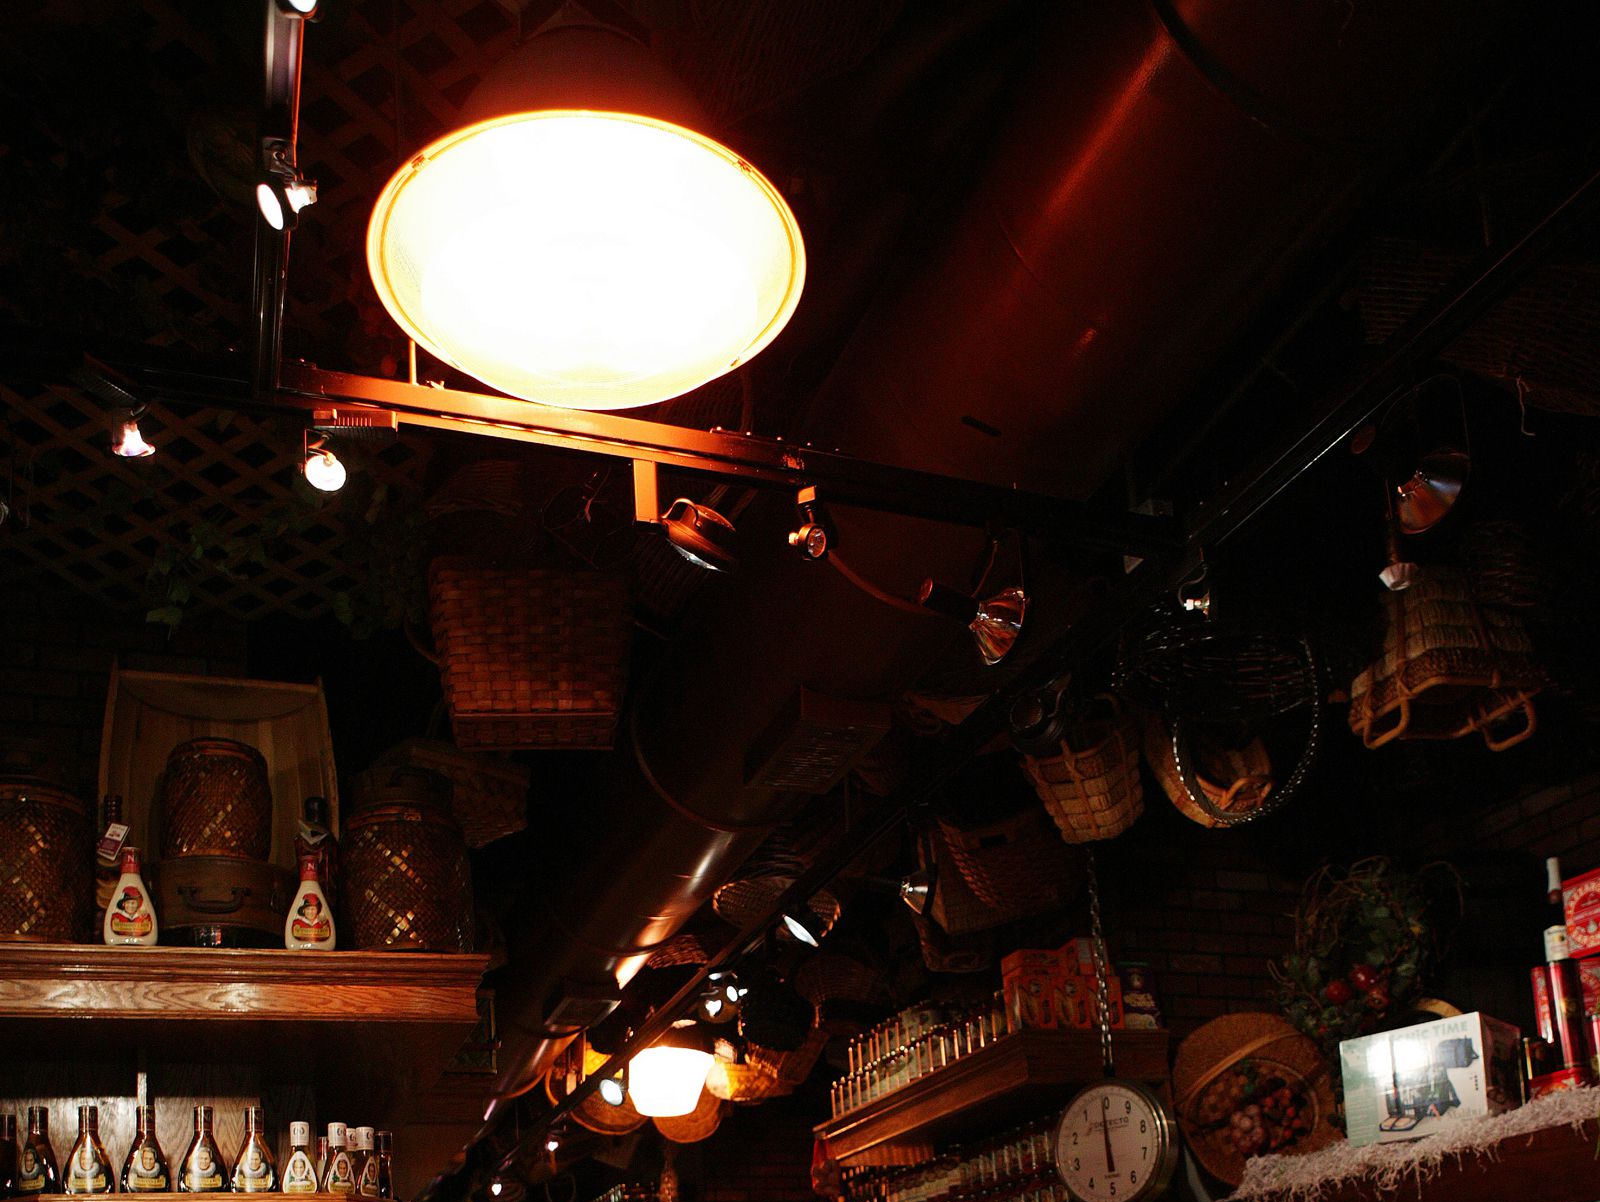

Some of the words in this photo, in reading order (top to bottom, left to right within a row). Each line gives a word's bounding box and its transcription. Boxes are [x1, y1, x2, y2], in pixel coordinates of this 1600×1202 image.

[1432, 1020, 1469, 1035] TIME
[1104, 1096, 1110, 1110] 0
[1125, 1100, 1131, 1114] 9
[1139, 1119, 1146, 1133] 8
[1072, 1132, 1078, 1145] 2
[1141, 1146, 1147, 1160] 7
[1074, 1158, 1080, 1171] 3
[1088, 1177, 1094, 1189] 4
[1130, 1170, 1137, 1184] 6
[1110, 1182, 1116, 1195] 5
